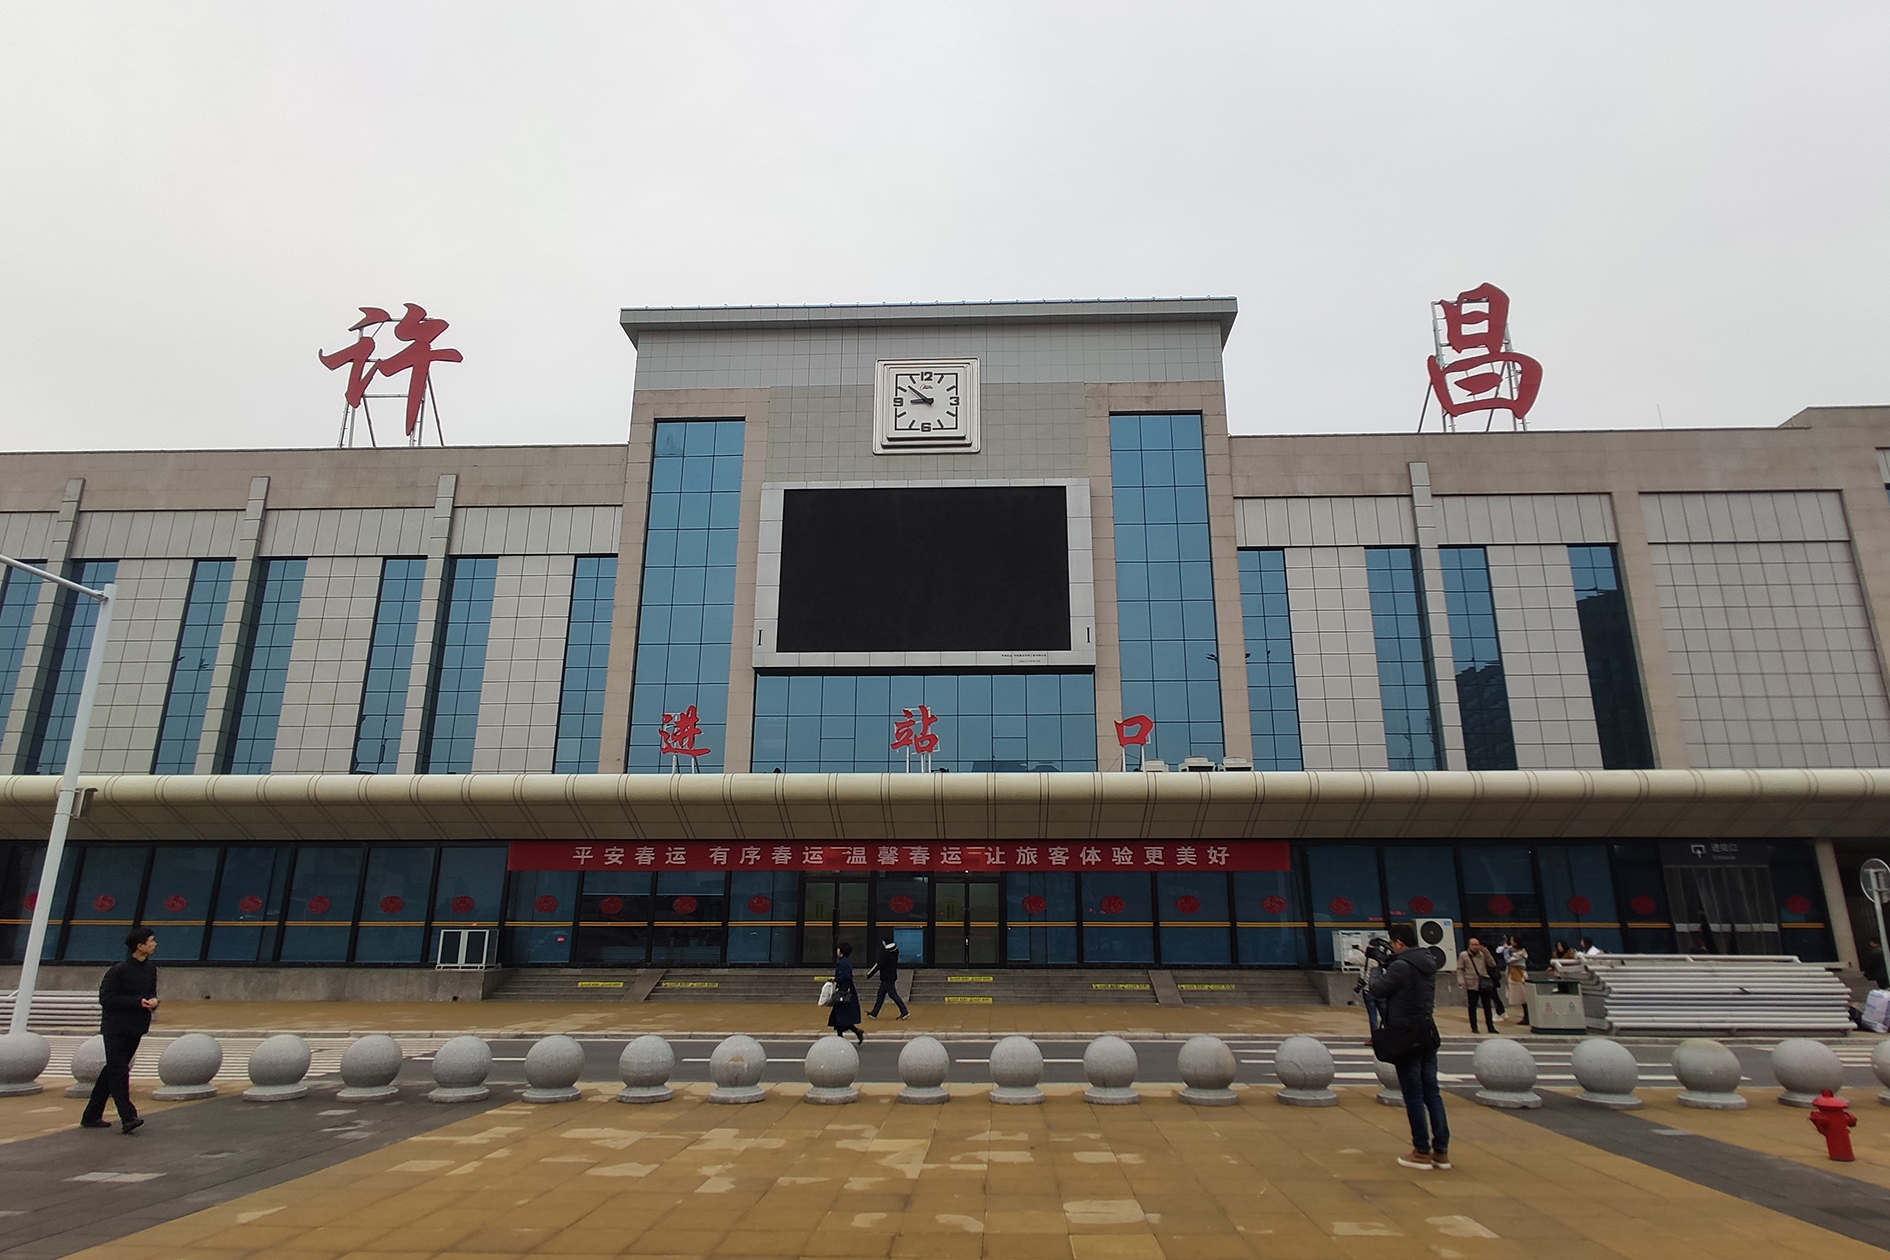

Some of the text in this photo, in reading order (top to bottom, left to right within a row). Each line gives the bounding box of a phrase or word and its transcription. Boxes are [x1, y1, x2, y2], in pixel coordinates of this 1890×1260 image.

[319, 282, 1543, 436] 许 昌
[920, 371, 933, 381] 12
[893, 397, 904, 407] 9
[949, 396, 960, 406] 3
[920, 422, 932, 432] 6
[659, 705, 1154, 757] 进 站 口
[573, 846, 1230, 865] 平安春运 有序春运 温馨春运 让旅客体验更美好
